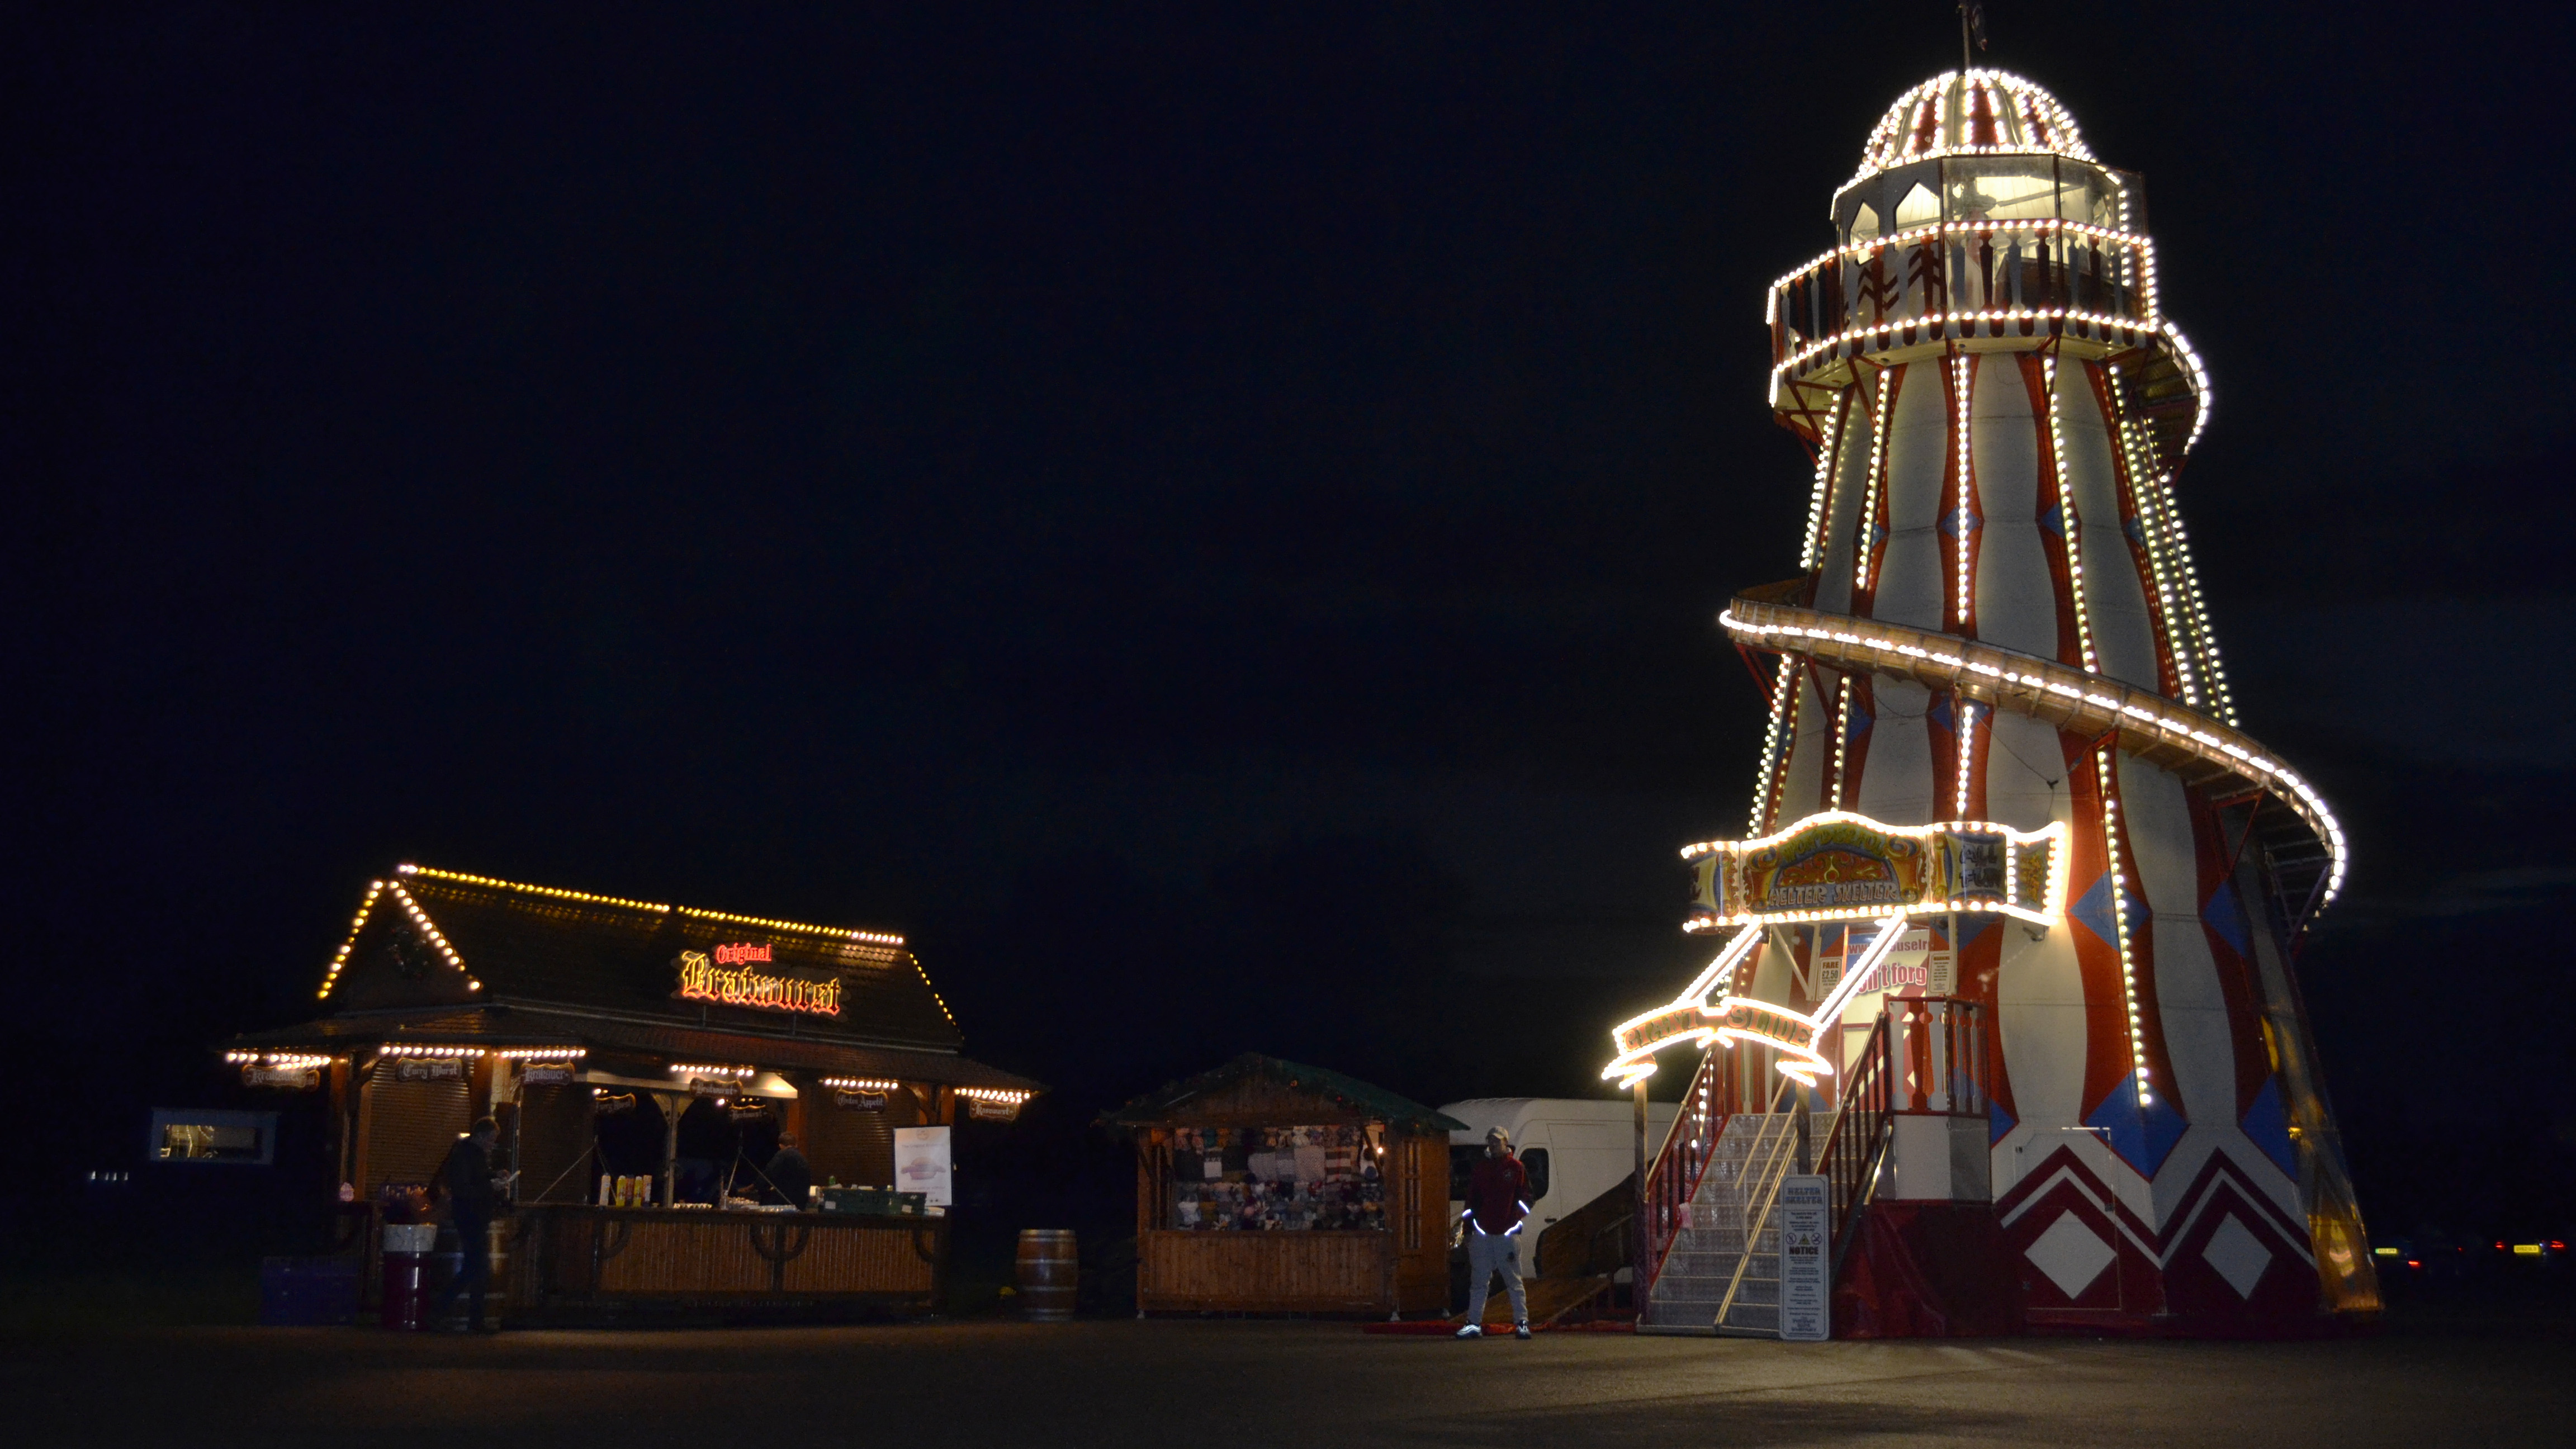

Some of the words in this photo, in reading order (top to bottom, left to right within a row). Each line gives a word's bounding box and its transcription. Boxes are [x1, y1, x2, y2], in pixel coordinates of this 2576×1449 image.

[1780, 823, 1887, 861] WONDERFUL
[1959, 844, 1997, 864] ALL
[1769, 886, 1827, 906] HELTER
[1834, 882, 1898, 903] SKELTER
[716, 943, 772, 964] Original
[681, 950, 840, 1015] Bratwurst
[1822, 970, 1838, 979] £2.50
[1623, 1008, 1701, 1052] GIANT
[1727, 1005, 1811, 1048] SLIDE
[403, 1064, 428, 1079] Curry
[431, 1064, 457, 1077] Wurst
[1789, 1246, 1819, 1255] NOTICE
